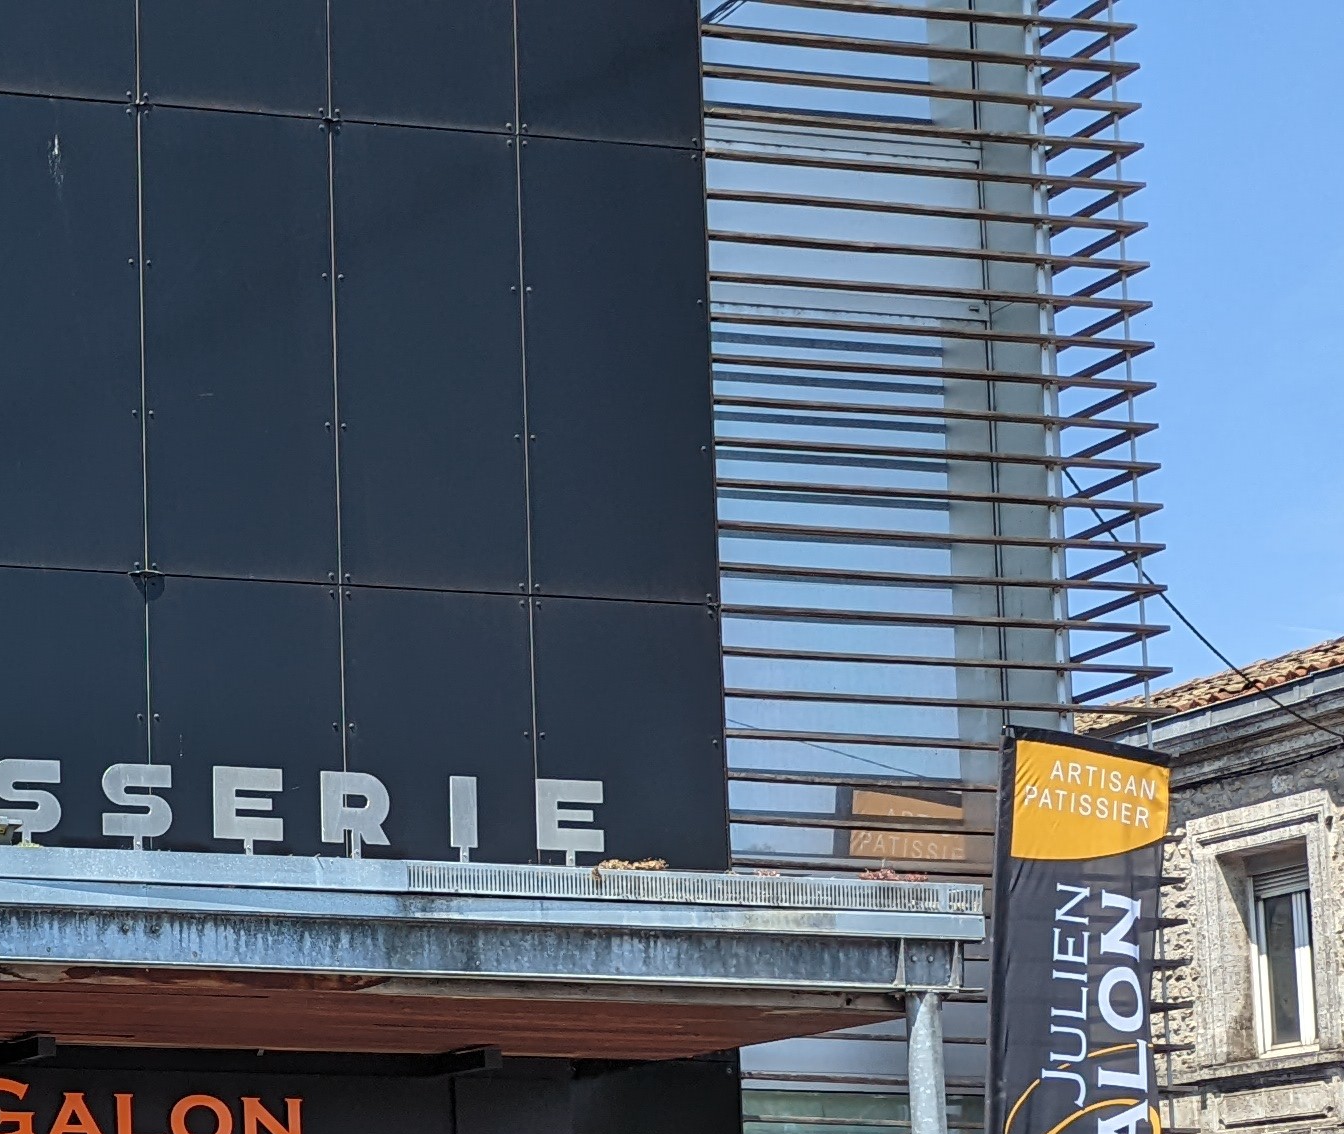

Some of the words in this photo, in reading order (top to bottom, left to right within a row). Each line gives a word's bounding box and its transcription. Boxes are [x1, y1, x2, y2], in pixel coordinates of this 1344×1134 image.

[1050, 760, 1156, 799] ARTISAN
[1023, 785, 1150, 829] PATISSIER
[1042, 882, 1091, 1107] JULIEN
